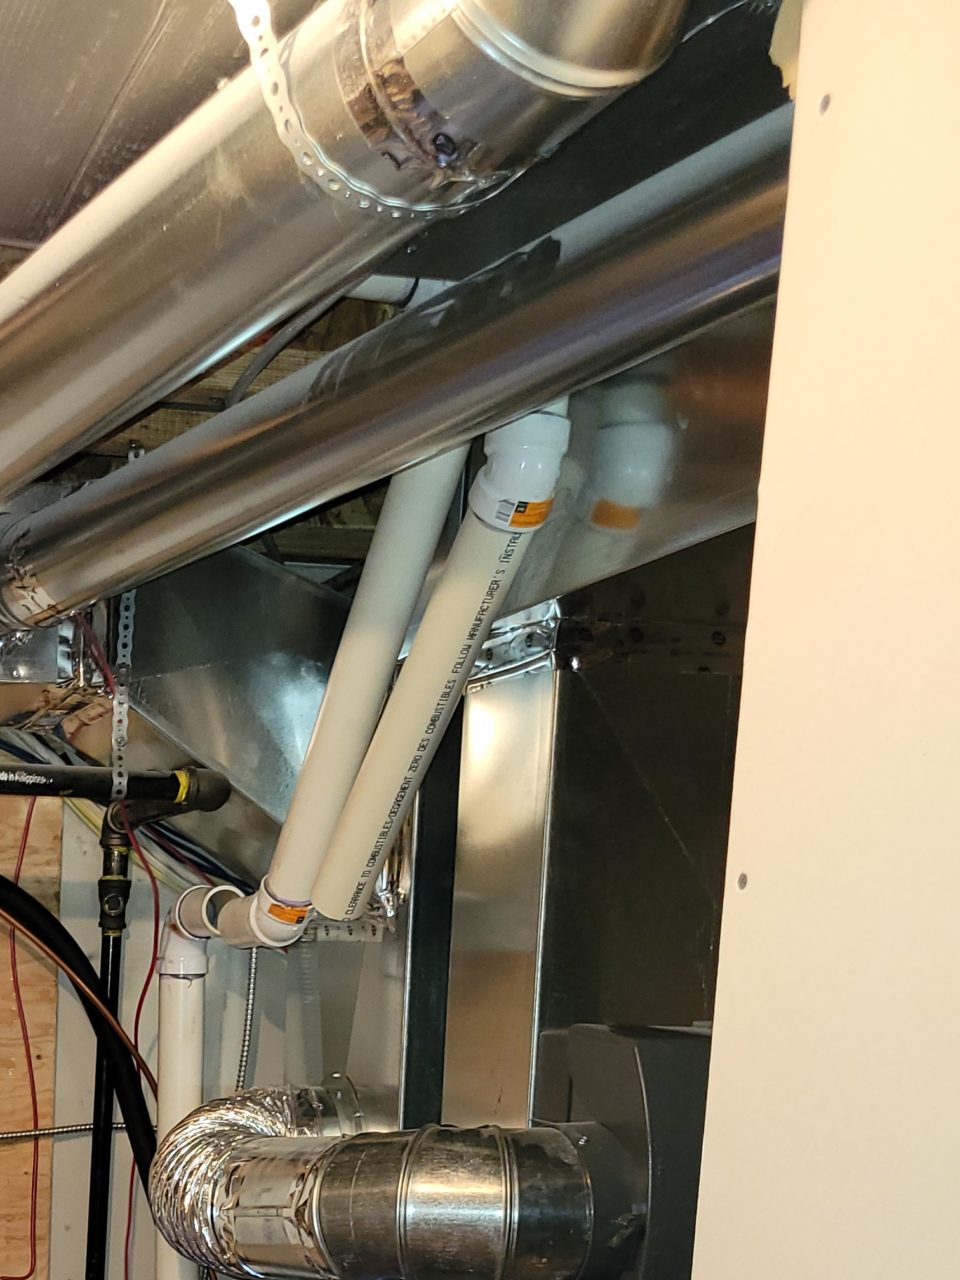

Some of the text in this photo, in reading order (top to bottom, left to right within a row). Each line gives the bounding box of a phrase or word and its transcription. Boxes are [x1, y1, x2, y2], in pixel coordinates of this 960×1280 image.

[345, 881, 367, 915] CLEARANCE
[361, 870, 372, 878] TO
[408, 755, 422, 773] ZERO
[417, 738, 430, 752] DES
[425, 679, 456, 735] COMBUSTIBLES
[452, 644, 472, 674] FOLLOW
[466, 569, 505, 641] MANUFACTURER'S
